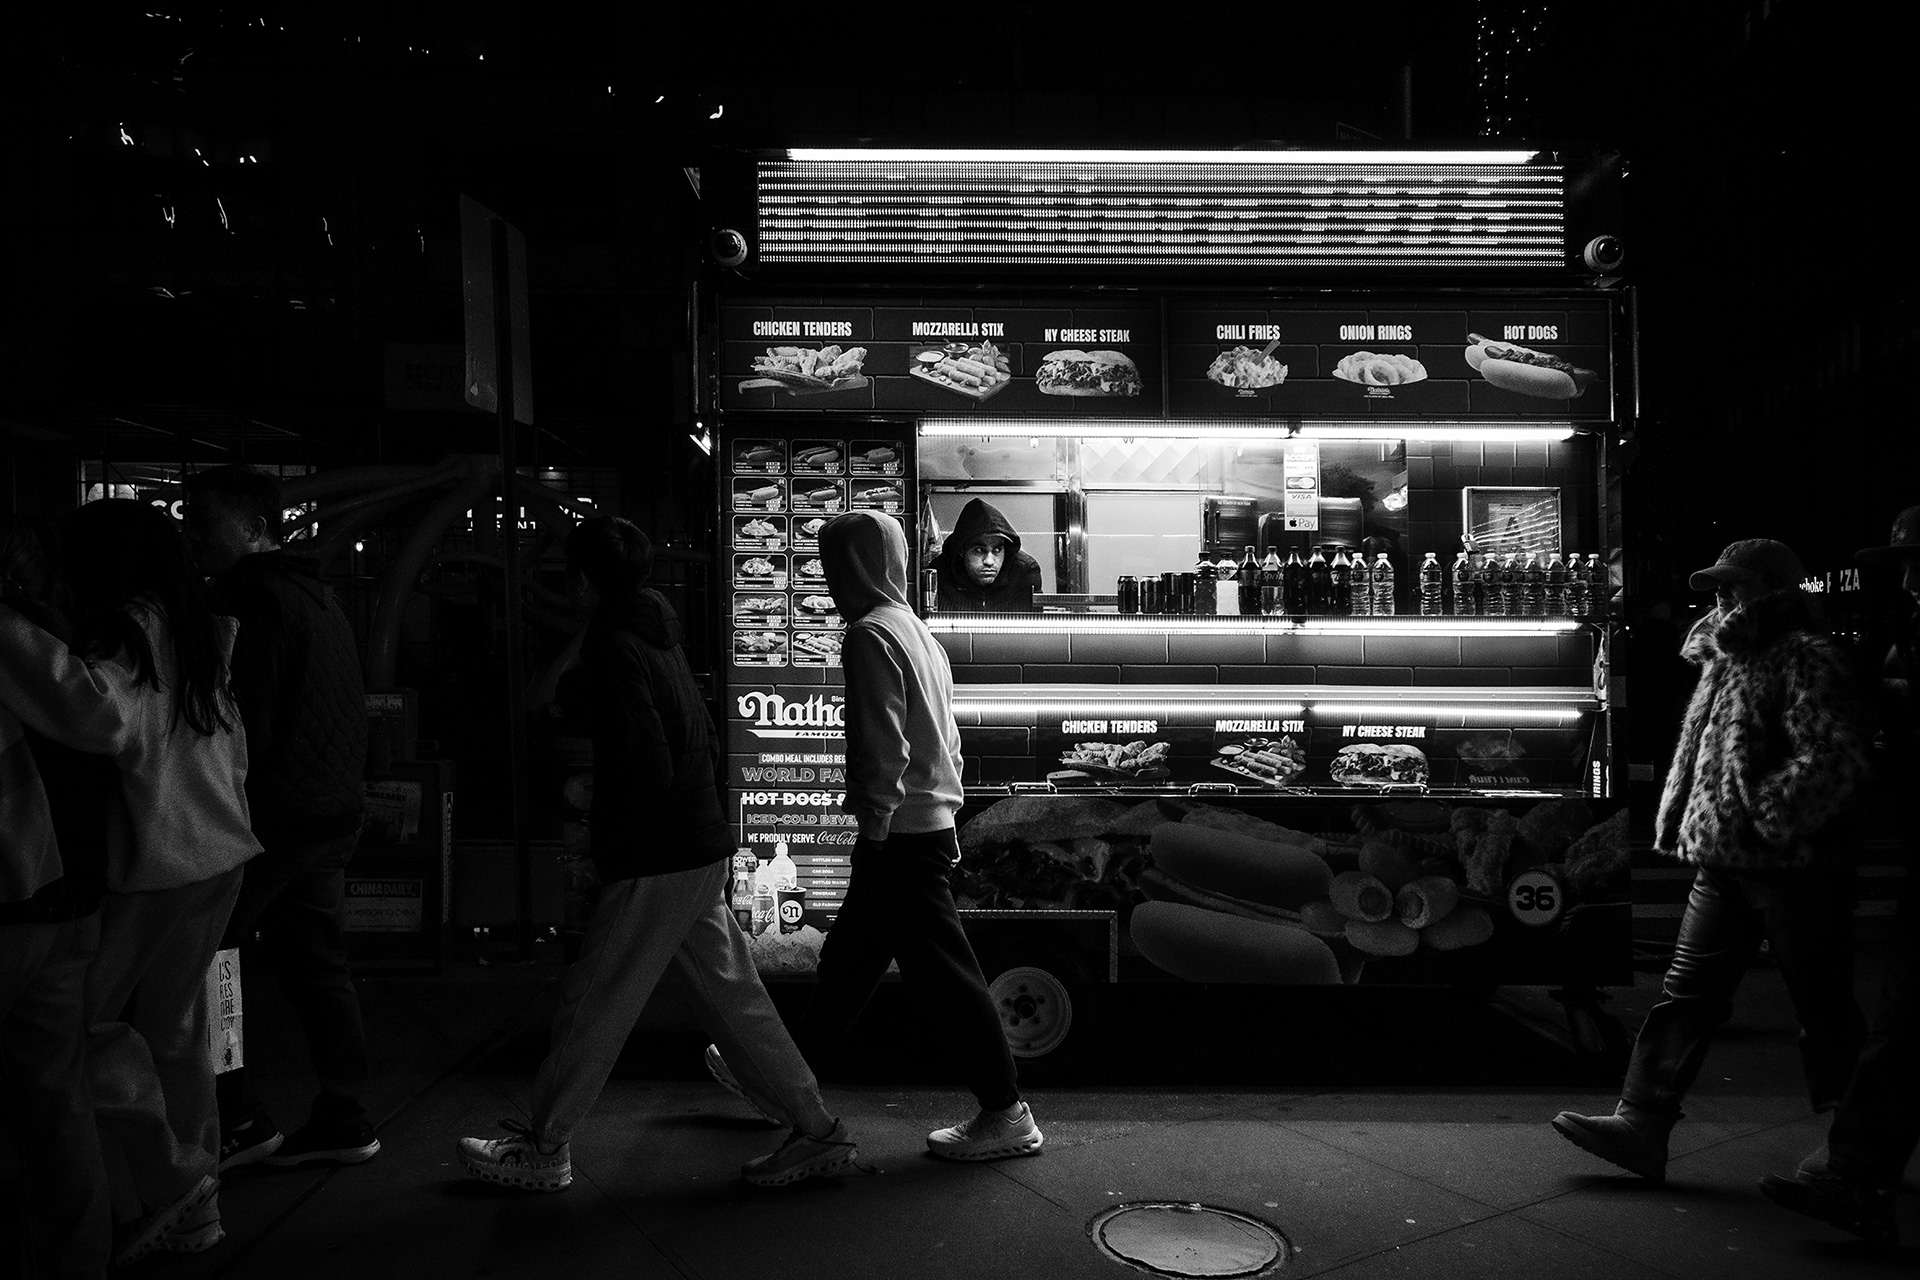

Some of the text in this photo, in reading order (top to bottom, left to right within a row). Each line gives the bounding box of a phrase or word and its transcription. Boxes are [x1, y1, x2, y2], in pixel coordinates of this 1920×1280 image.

[753, 321, 853, 337] CHICKEN TENDERS
[912, 322, 1004, 337] MOZZARELLA STIX
[1044, 328, 1131, 343] NY CHEESE STEAK
[1216, 324, 1281, 341] CHILI FRIES
[1339, 325, 1412, 341] ONION RINGS
[1503, 325, 1558, 340] HOT DOGS
[1298, 517, 1316, 530] Pay
[1826, 567, 1861, 594] PZA
[1062, 720, 1158, 734] CHICKEN TENDERS
[1215, 720, 1305, 734] MOZZARELLA STIX
[1342, 725, 1427, 739] NY CHEESE STEAK
[761, 754, 784, 763] COMBO
[785, 754, 803, 763] MEAL
[804, 754, 834, 763] INCLUDES
[741, 766, 846, 783] WORLD FA
[741, 792, 779, 806] HOT
[782, 792, 832, 806] DOGS
[746, 813, 818, 824] ICED-COLD
[747, 832, 759, 843] WE
[792, 833, 816, 844] SERVE
[1515, 885, 1555, 912] 36
